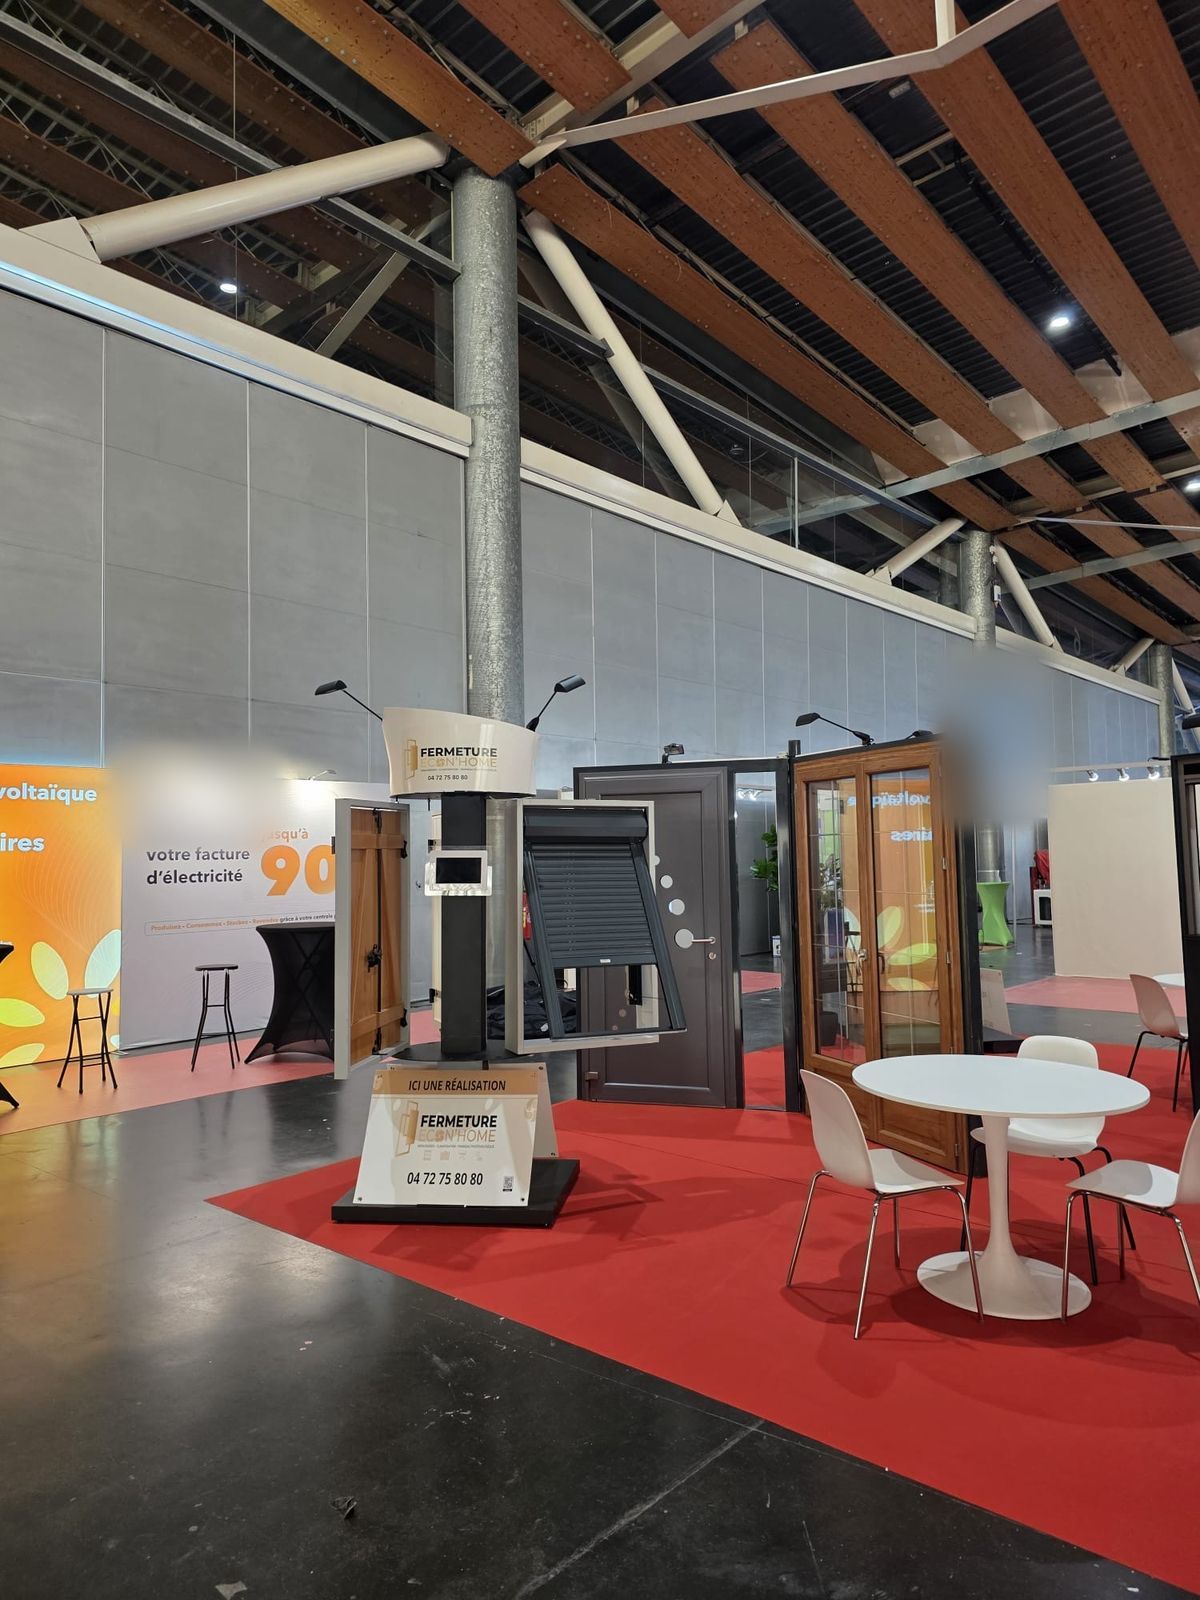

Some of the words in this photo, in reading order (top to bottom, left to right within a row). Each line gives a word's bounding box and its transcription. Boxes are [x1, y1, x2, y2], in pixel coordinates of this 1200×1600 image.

[420, 747, 498, 757] FERMETURE
[0, 832, 45, 852] ires
[146, 848, 191, 861] votre
[195, 847, 250, 861] facture
[146, 869, 243, 885] d'électricité
[260, 844, 336, 897] 90
[408, 1080, 420, 1091] ICI
[423, 1080, 443, 1091] UNE
[445, 1078, 506, 1091] RÉALISATION
[420, 1115, 497, 1128] FERMETURE
[407, 1172, 420, 1184] 04
[423, 1172, 436, 1185] 72
[439, 1172, 451, 1185] 75
[454, 1172, 467, 1185] 80
[470, 1172, 483, 1185] 80
